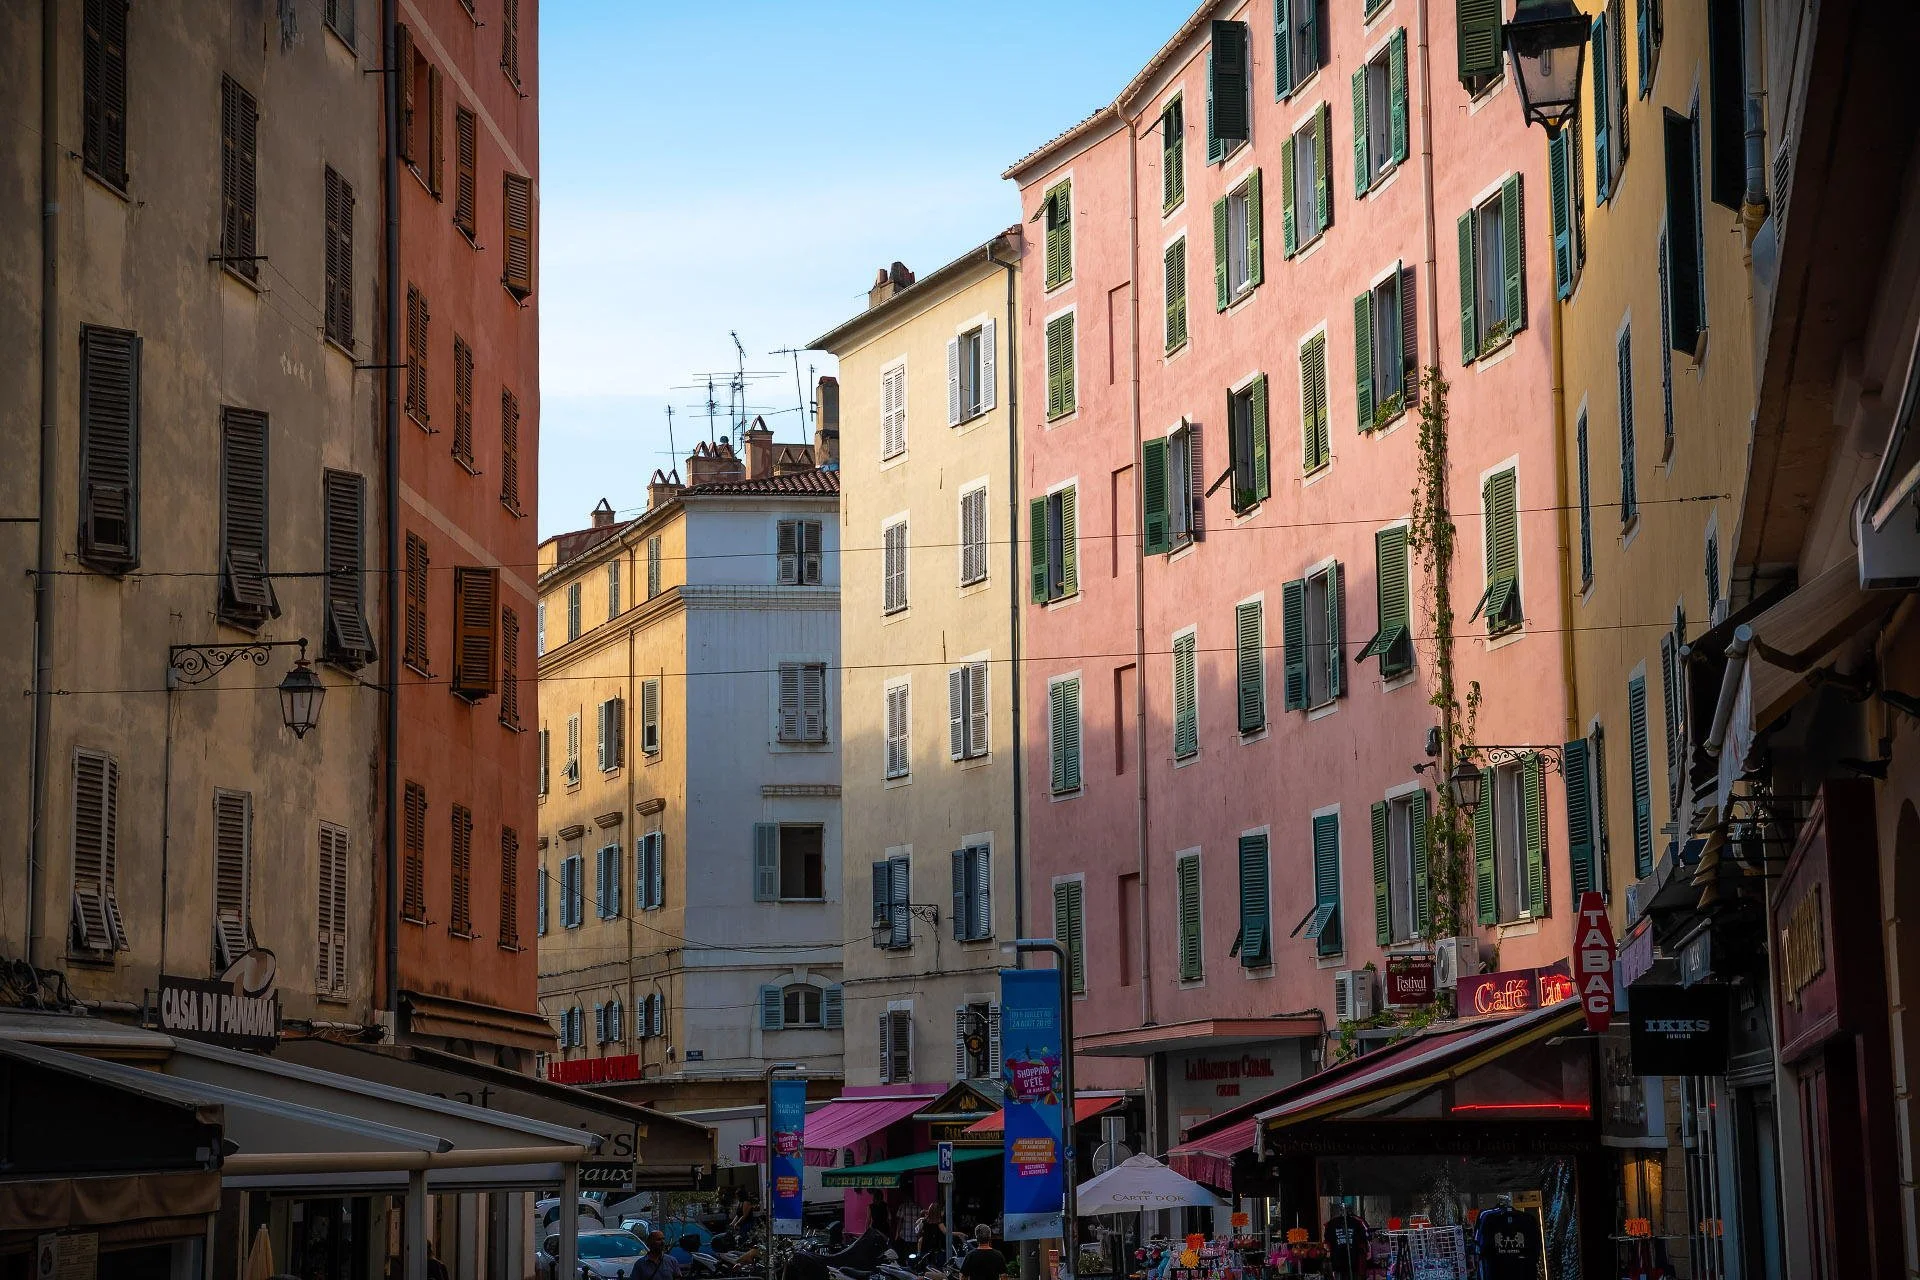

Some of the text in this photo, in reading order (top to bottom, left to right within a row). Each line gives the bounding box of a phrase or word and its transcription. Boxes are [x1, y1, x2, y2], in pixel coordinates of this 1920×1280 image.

[1581, 909, 1612, 1013] TABAC
[1396, 975, 1427, 992] Festival
[1475, 978, 1526, 1013] Café
[161, 986, 275, 1037] CASA DI PANAMA
[1644, 1019, 1711, 1032] IKKS
[1017, 1066, 1050, 1079] SHOPPING
[1023, 1076, 1044, 1088] D'ÉTÉ
[1112, 1193, 1186, 1202] CARTE D'OR
